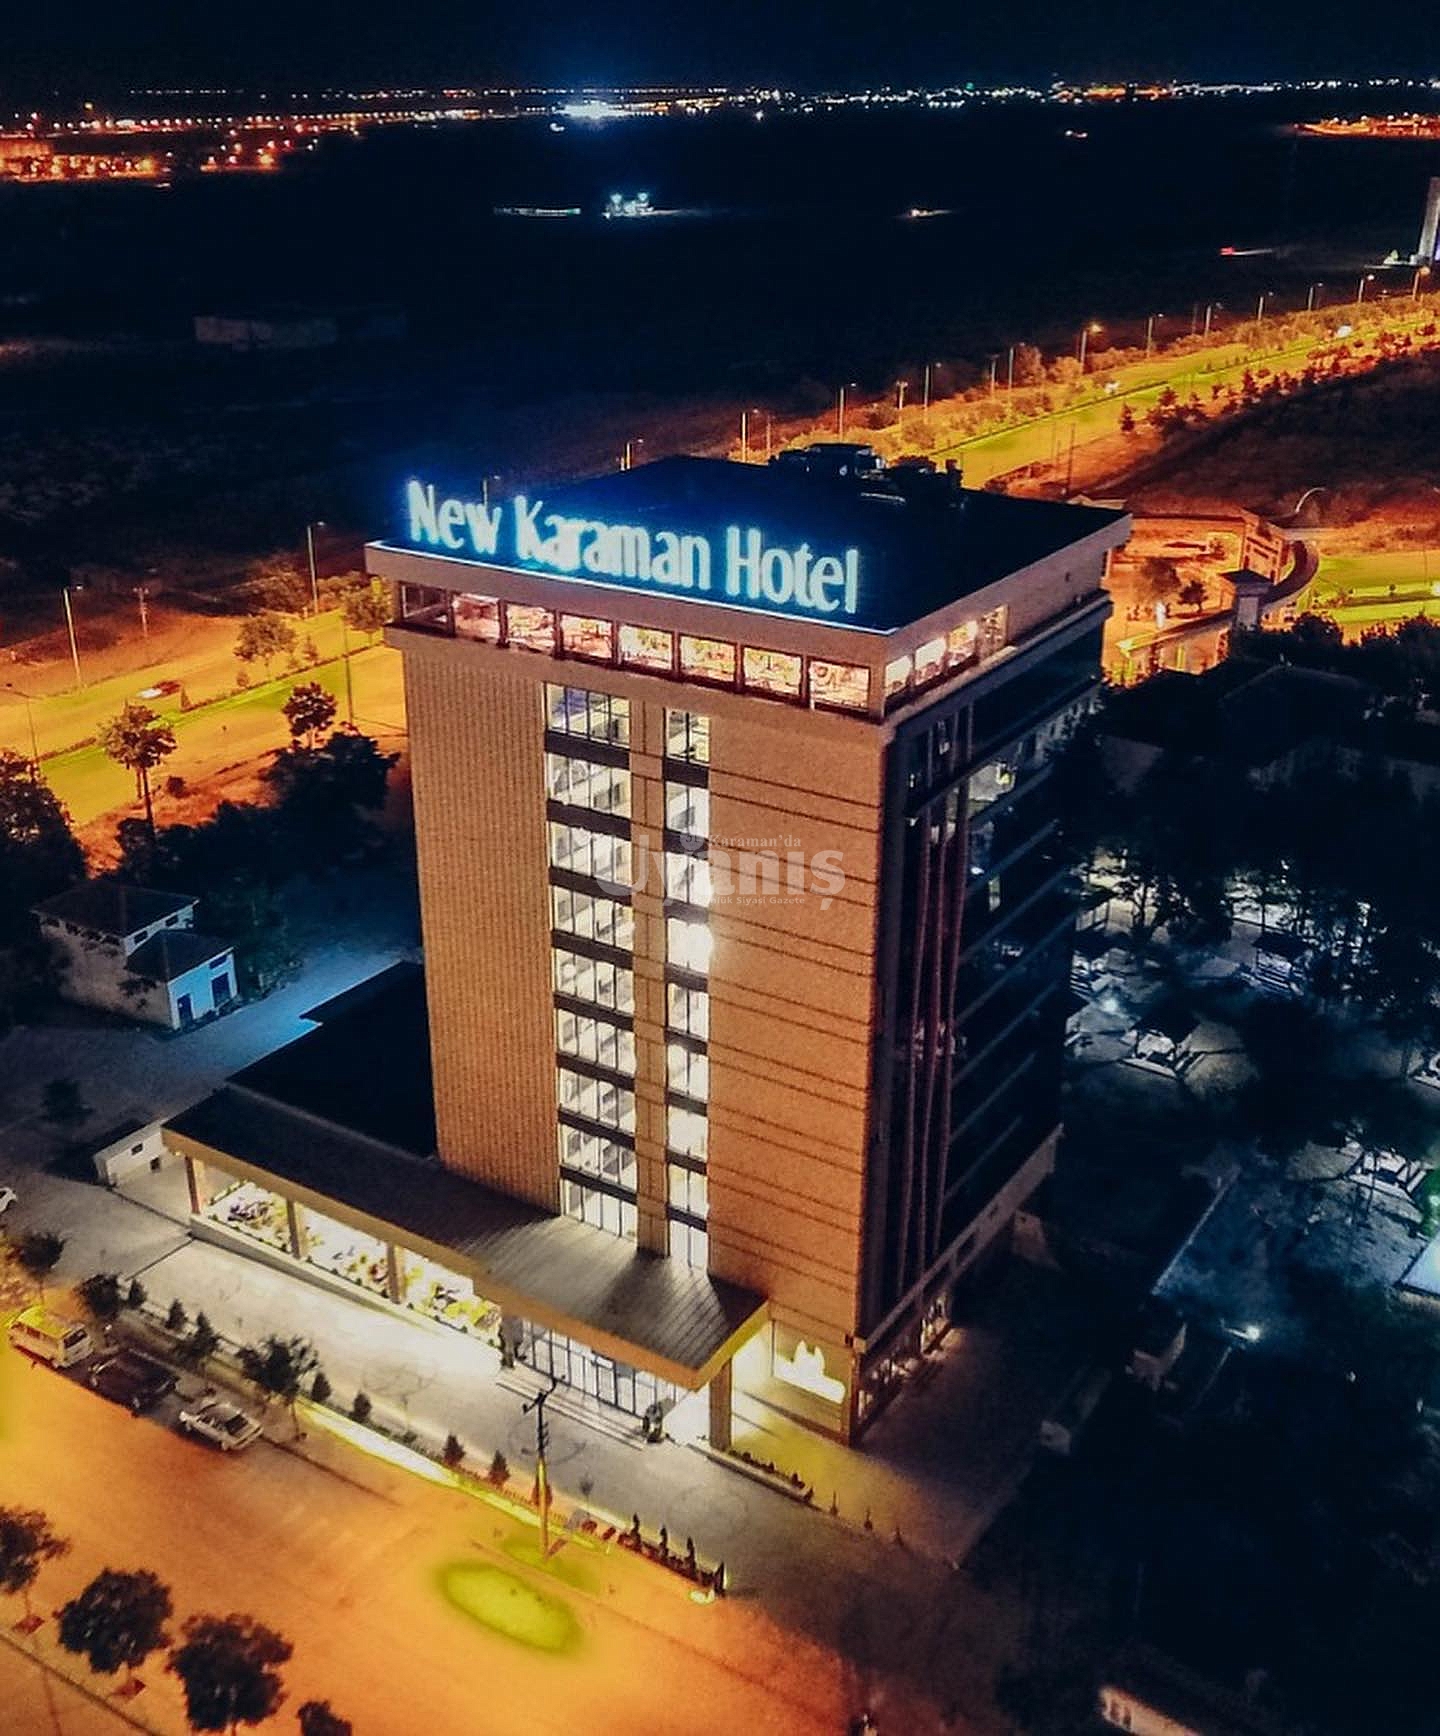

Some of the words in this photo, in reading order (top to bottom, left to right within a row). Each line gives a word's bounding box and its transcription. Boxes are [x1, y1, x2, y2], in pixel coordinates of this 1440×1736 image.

[407, 479, 502, 555] New
[515, 495, 711, 590] Karaman
[726, 525, 859, 614] Hotel
